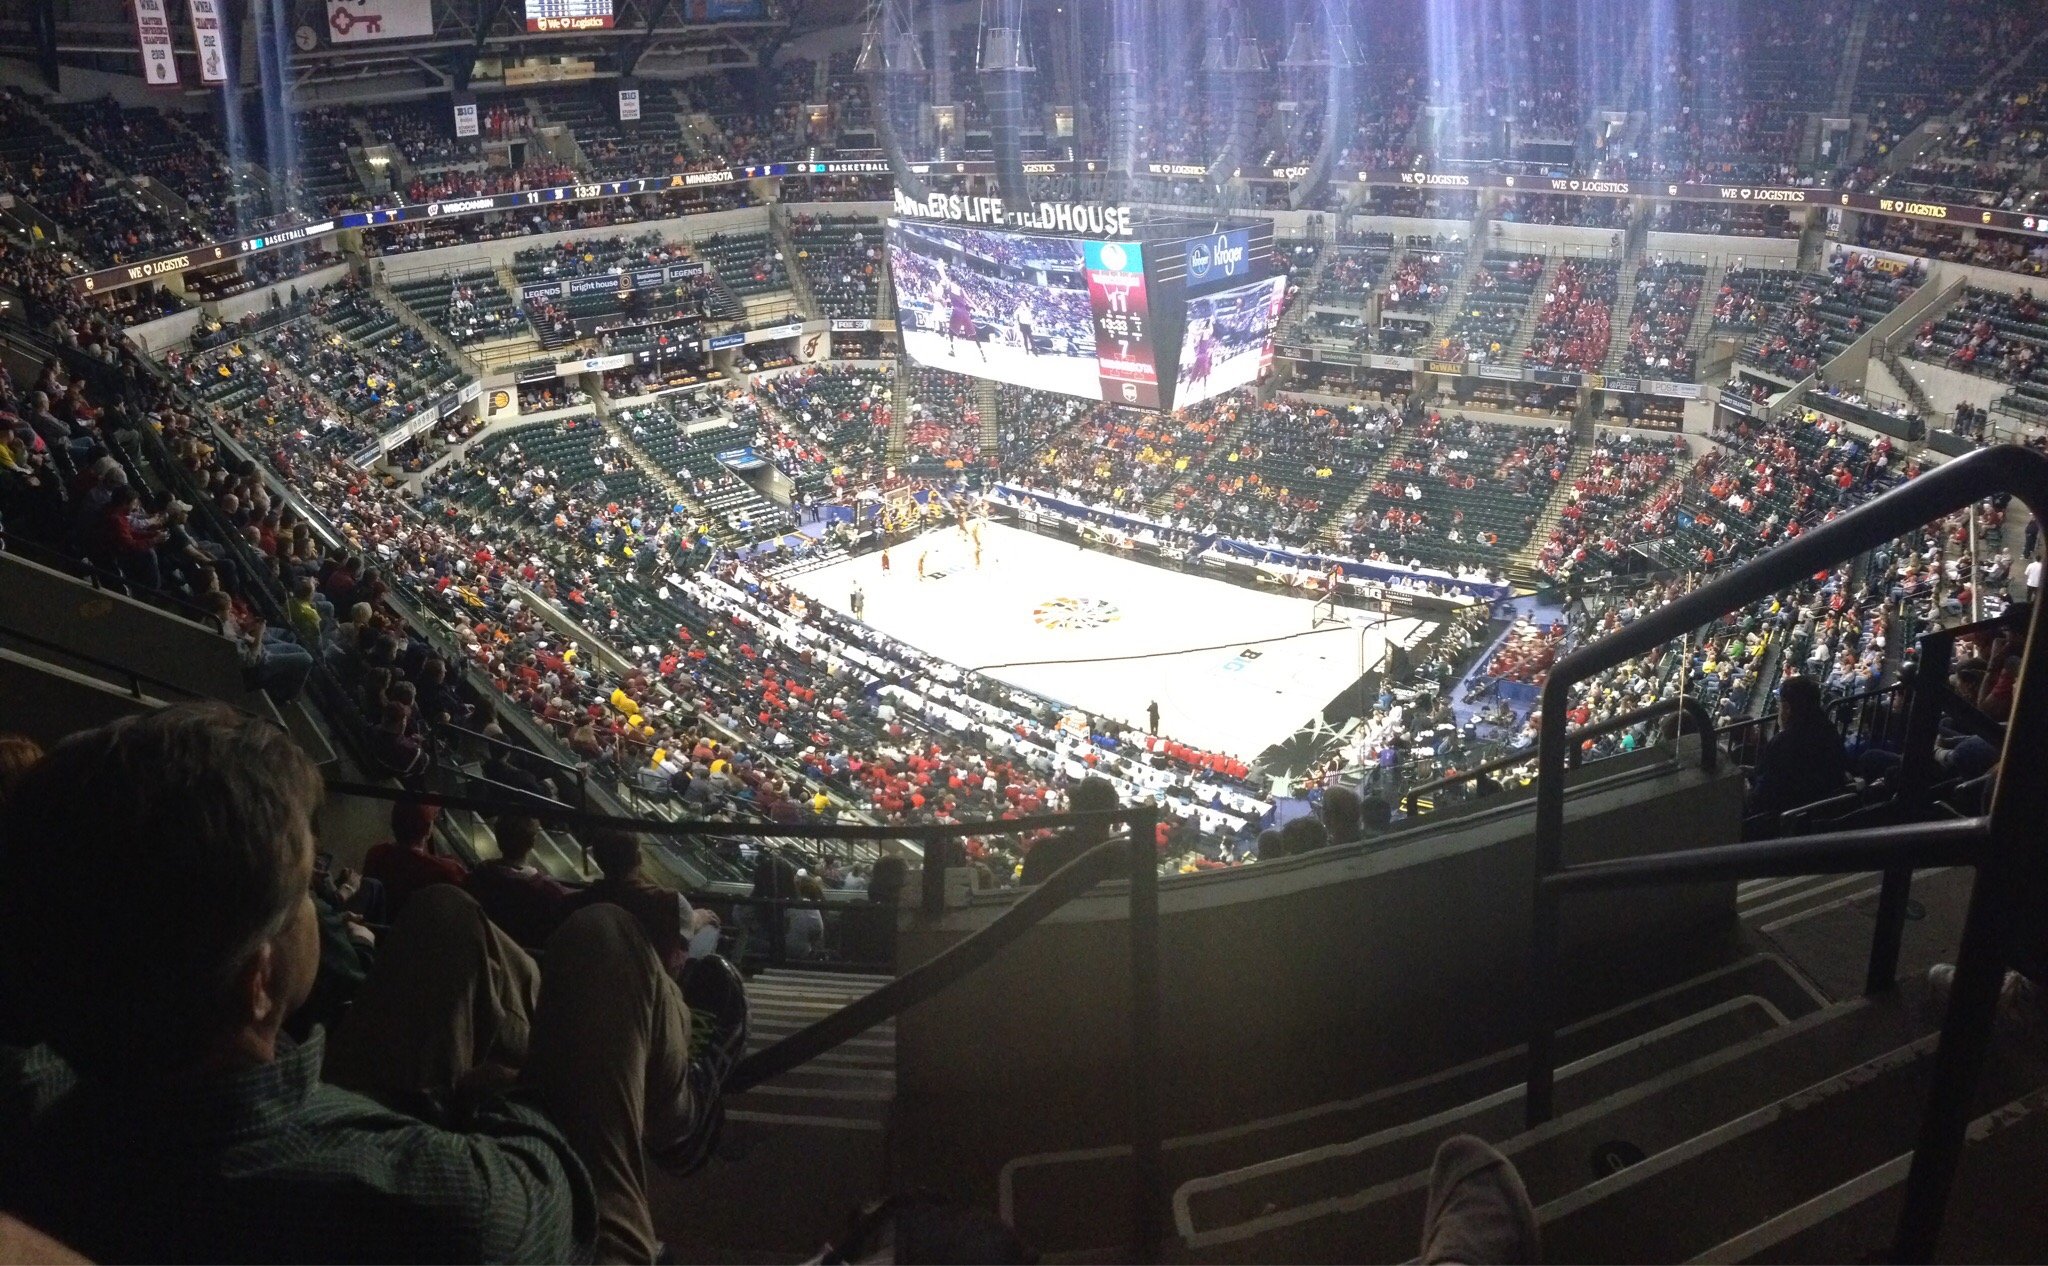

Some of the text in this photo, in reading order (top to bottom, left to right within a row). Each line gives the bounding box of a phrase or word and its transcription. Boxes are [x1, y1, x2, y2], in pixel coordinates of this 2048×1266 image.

[547, 17, 603, 29] We Logistics
[829, 163, 889, 172] BASKETBALL
[1149, 164, 1206, 175] WE LOGISTICS
[1273, 168, 1284, 177] WE
[1401, 173, 1469, 186] WE LOGISTICS
[1552, 179, 1629, 193] WE LOGISTICS
[442, 198, 494, 214] WISCONSIN
[527, 192, 539, 204] 11
[575, 185, 601, 199] 13:37
[638, 180, 645, 191] 7
[686, 171, 733, 185] MINNESOTA
[1721, 188, 1805, 202] WE LOGISTICS
[963, 196, 1004, 224] LIFE
[1880, 199, 1947, 218] WE LOGISTICS
[265, 229, 305, 246] BASKETBALL
[1214, 235, 1243, 276] Kroger
[128, 256, 190, 279] WE LOGISTICS
[670, 267, 702, 278] LEGENDS
[524, 287, 561, 299] LEGENDS
[571, 280, 619, 292] bright house
[1109, 291, 1127, 312] 11
[1118, 340, 1128, 358] 7
